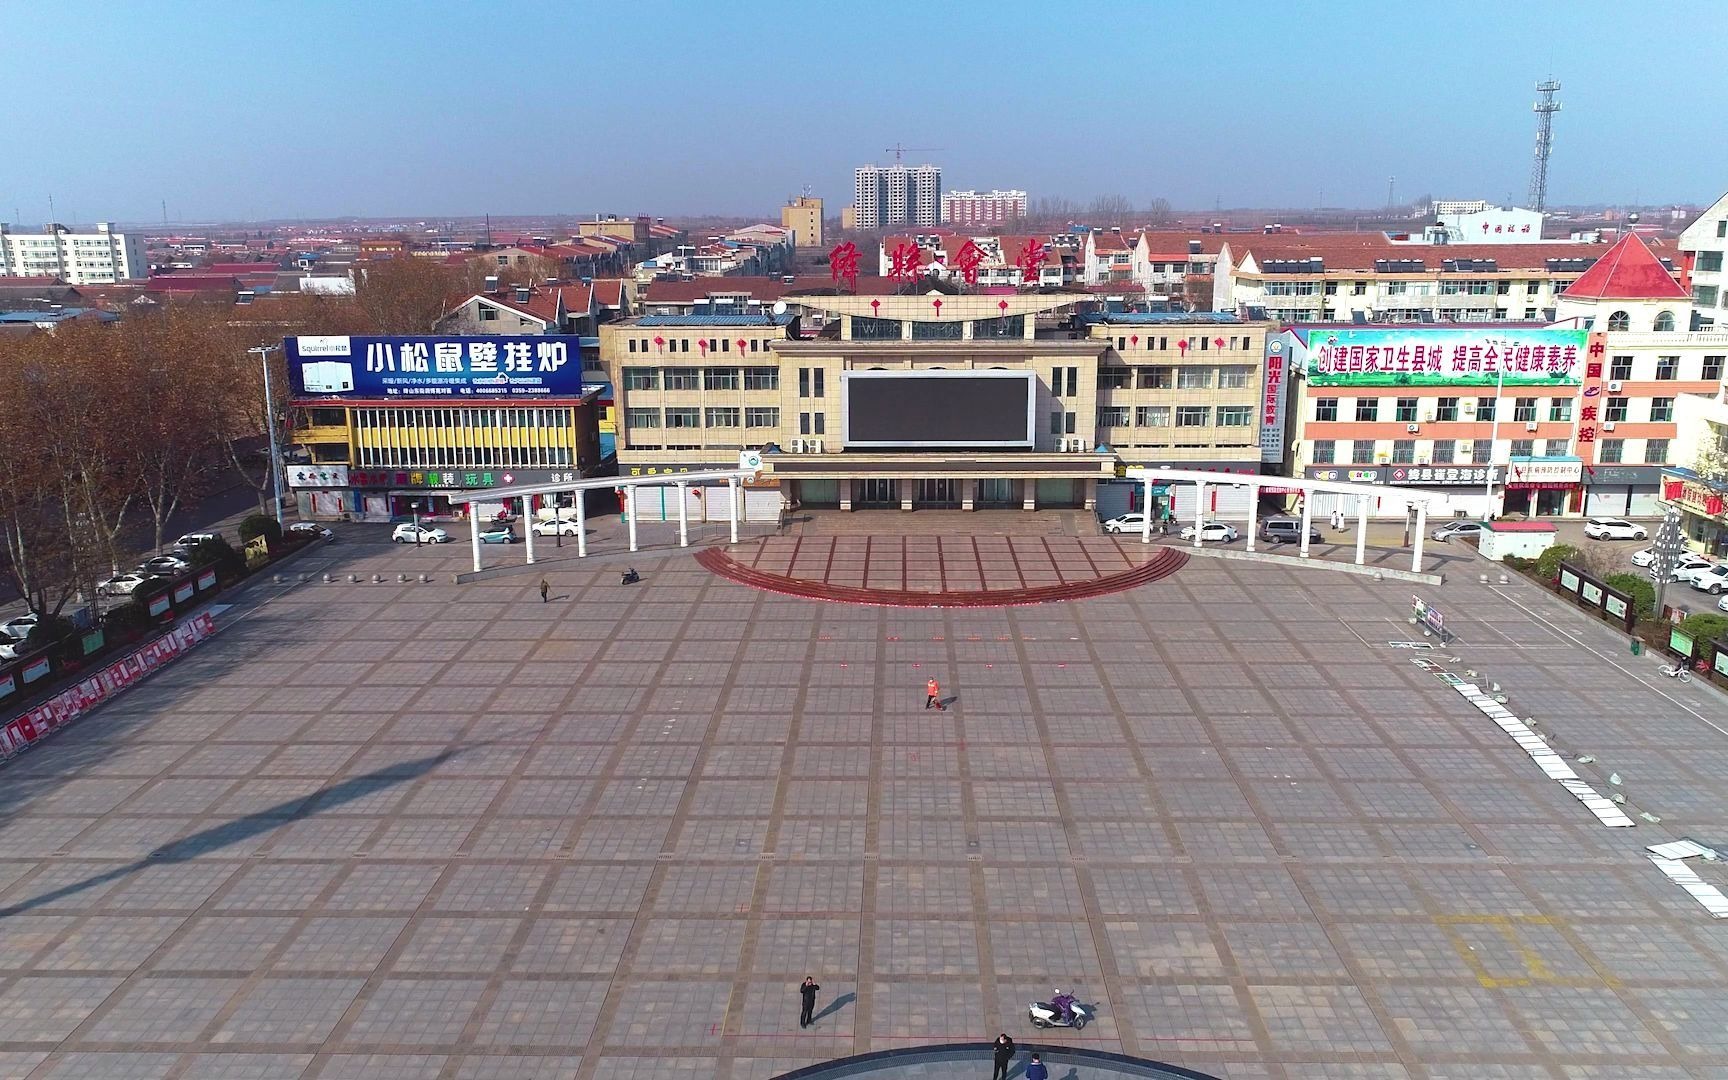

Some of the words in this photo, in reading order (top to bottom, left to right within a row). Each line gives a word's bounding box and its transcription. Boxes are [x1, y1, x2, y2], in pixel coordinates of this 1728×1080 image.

[366, 342, 567, 373] 小松鼠壁挂炉
[1317, 345, 1443, 372] 创建国家卫生县城
[1451, 345, 1577, 372] 提高全民健康素养
[464, 472, 494, 486] 玩具
[551, 472, 573, 483] 诊所
